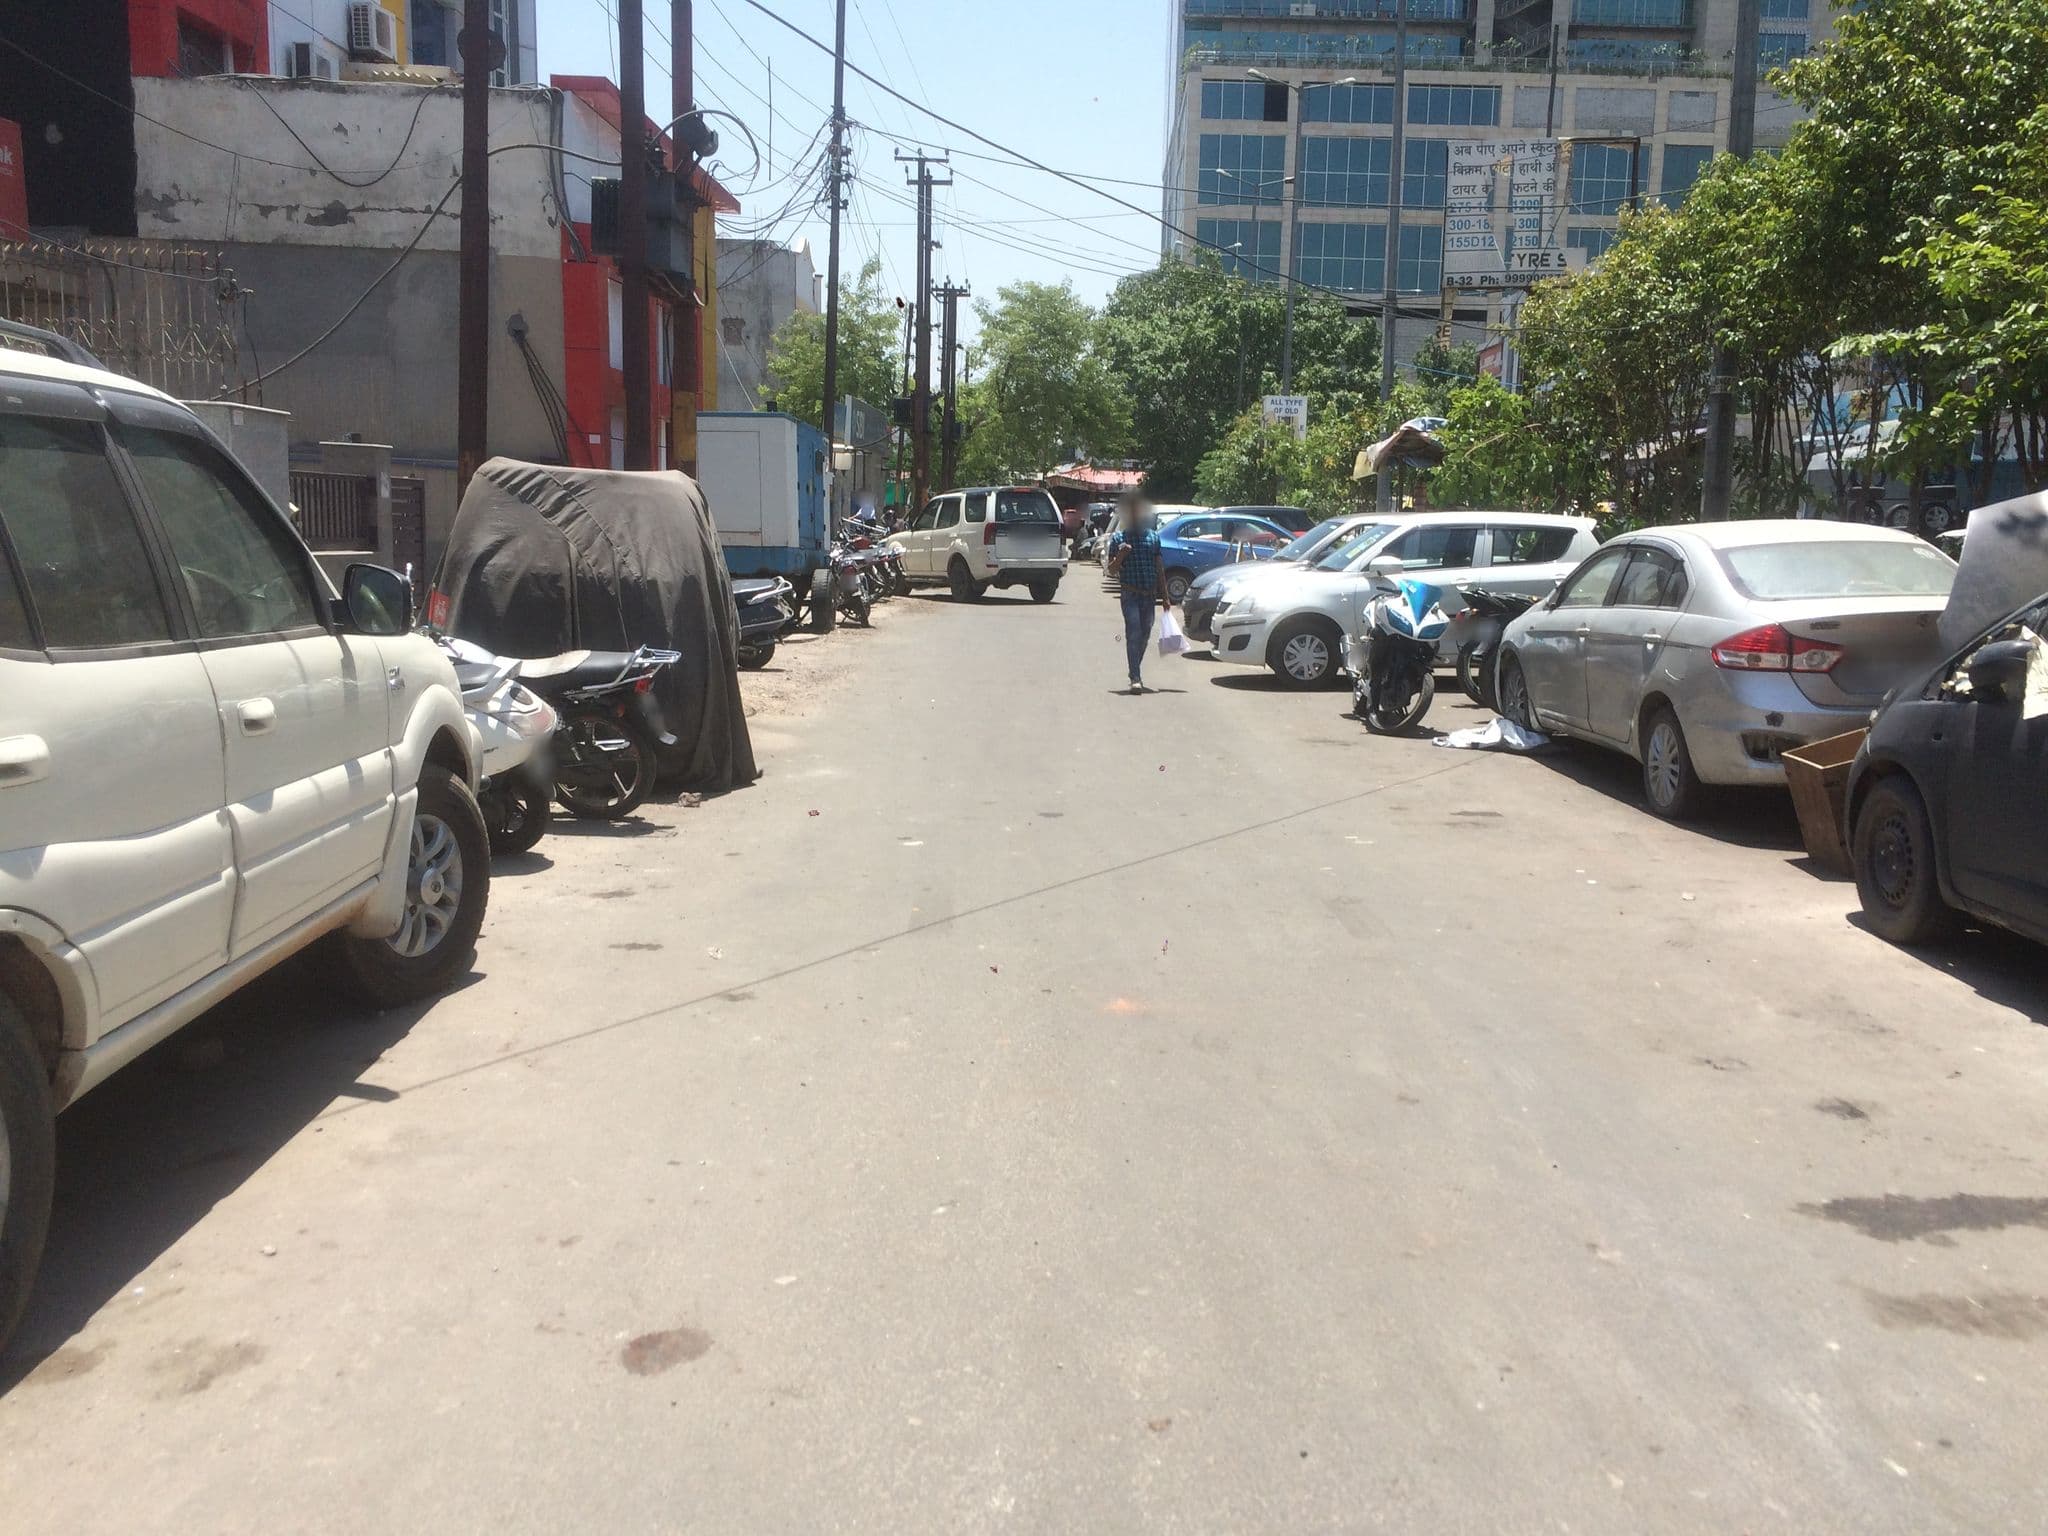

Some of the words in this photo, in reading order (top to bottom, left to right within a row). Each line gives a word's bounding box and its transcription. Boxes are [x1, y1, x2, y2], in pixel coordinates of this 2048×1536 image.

[1454, 145, 1472, 156] अब
[1499, 139, 1526, 154] अपने
[1519, 159, 1542, 176] हाथी
[1452, 184, 1477, 196] टायर
[1513, 178, 1538, 194] फटने
[1446, 275, 1473, 286] B-32
[1480, 275, 1500, 285] Ph:
[1270, 398, 1283, 406] ALL
[1285, 399, 1303, 407] TYPE
